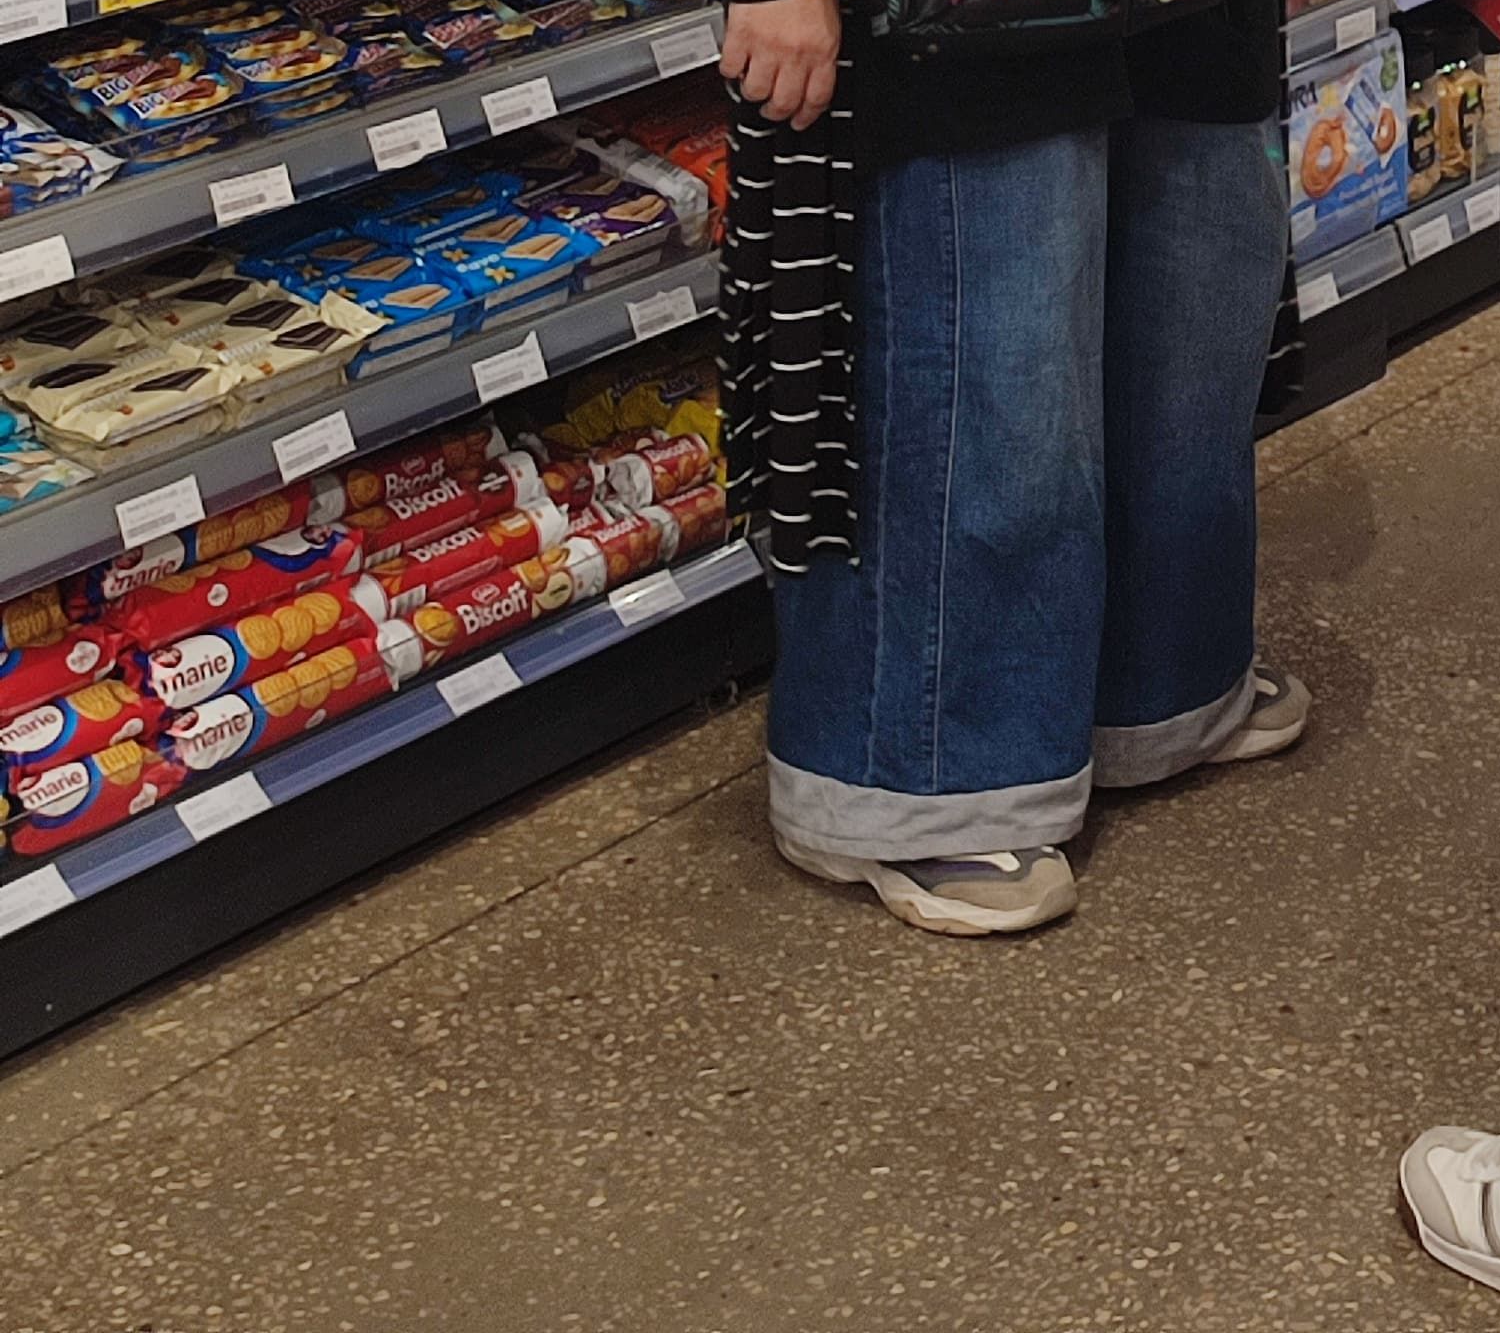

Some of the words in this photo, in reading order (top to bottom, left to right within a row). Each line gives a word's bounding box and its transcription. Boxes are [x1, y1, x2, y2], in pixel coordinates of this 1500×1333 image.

[97, 77, 130, 100] BIG
[134, 92, 164, 115] BIG
[111, 558, 176, 591] marie
[456, 581, 529, 635] Biscoff
[160, 654, 227, 694] marie
[0, 713, 57, 746] marie
[24, 770, 82, 805] marie
